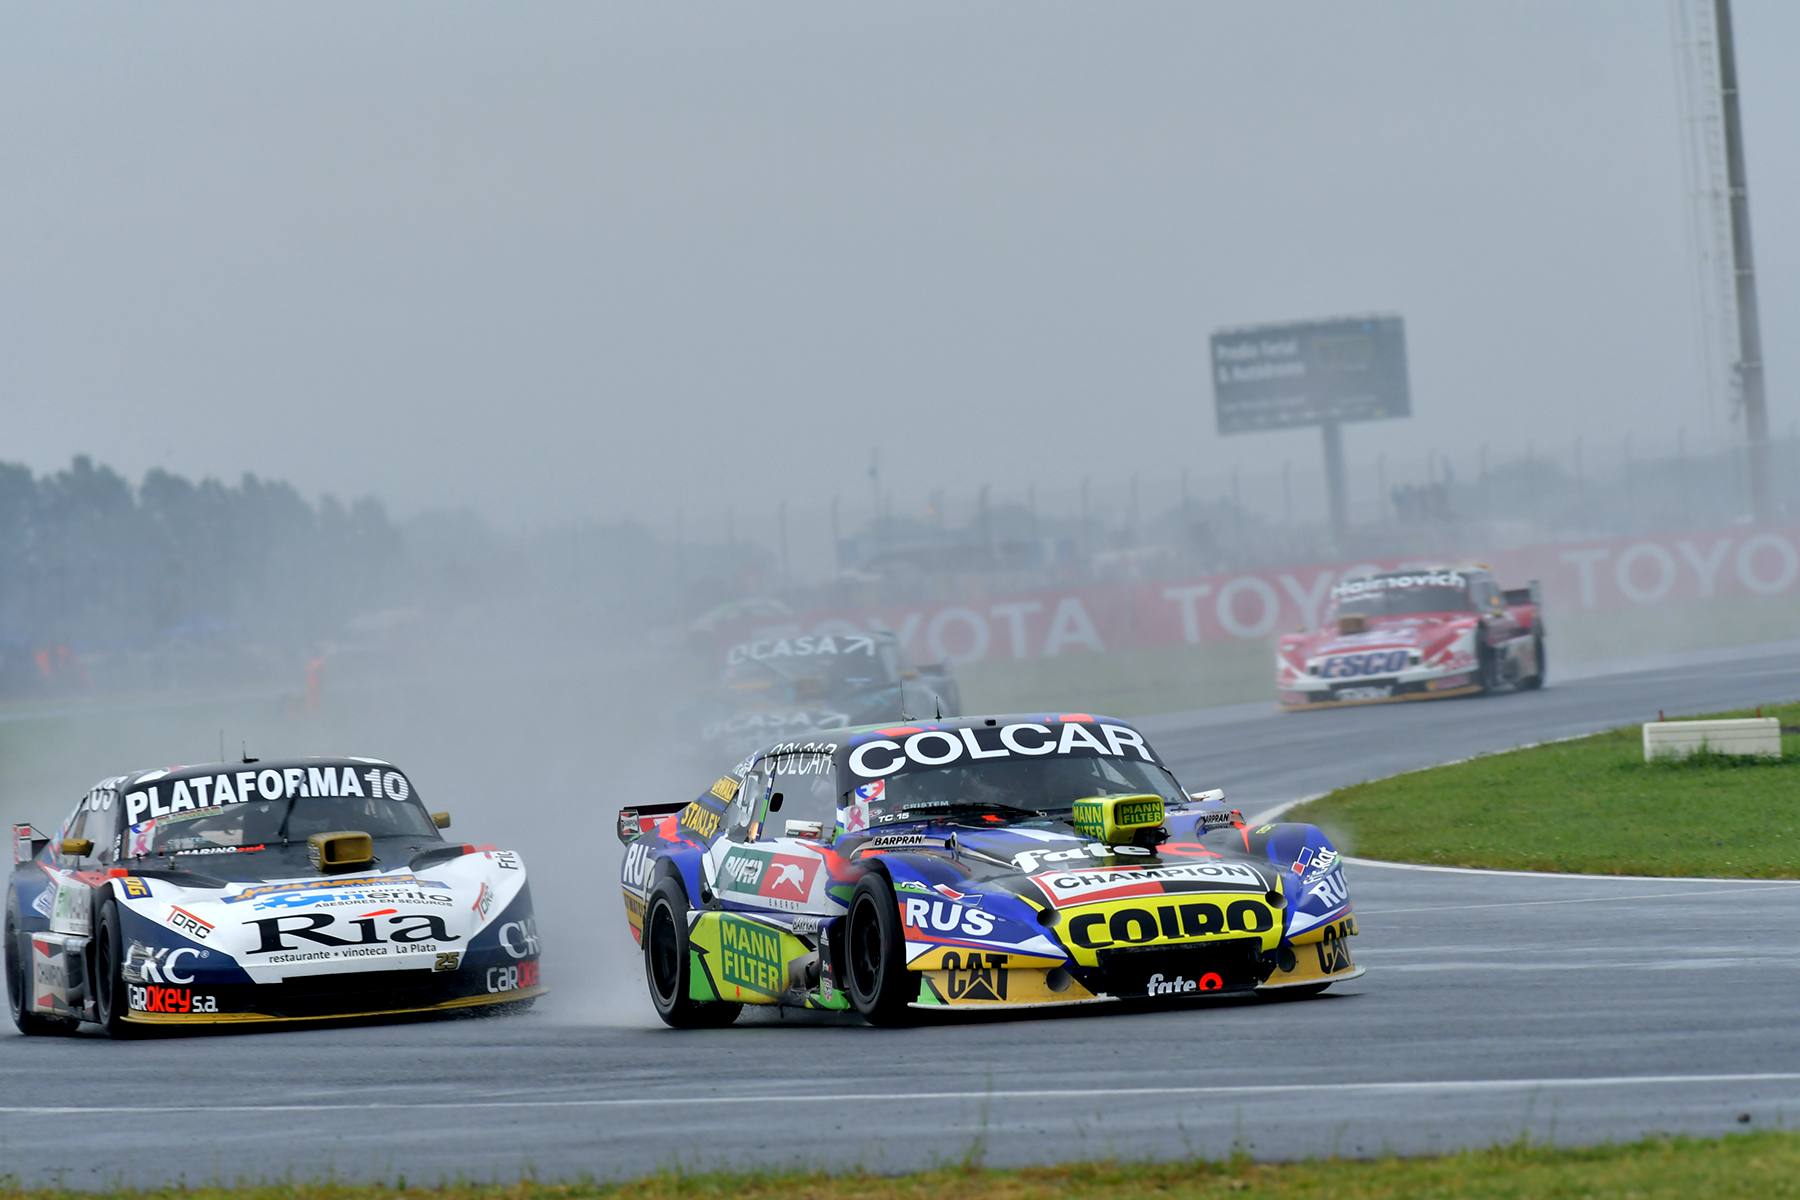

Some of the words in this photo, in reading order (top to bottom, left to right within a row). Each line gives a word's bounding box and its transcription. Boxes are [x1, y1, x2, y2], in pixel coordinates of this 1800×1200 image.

[1559, 534, 1799, 608] TOYO
[1162, 563, 1385, 644] TOY
[812, 597, 1105, 665] YOTA
[764, 742, 838, 776] COLCAR
[849, 722, 1155, 778] COLCAR
[680, 801, 721, 839] STANLEY
[879, 814, 894, 823] TC
[896, 812, 910, 820] 15
[1073, 806, 1103, 823] MANN
[1123, 803, 1160, 814] MANN
[1124, 812, 1161, 824] FILTER
[1203, 813, 1230, 824] ARPRAN
[874, 836, 923, 846] BARPRAN
[1011, 842, 1152, 874] fate
[1053, 863, 1250, 889] CHAMPION
[1308, 865, 1350, 908] RU
[314, 900, 371, 908] ASESORES
[399, 899, 453, 907] SEGUROS
[906, 897, 996, 937] RUS
[167, 904, 215, 939] TORC
[498, 918, 541, 959] CK
[1068, 899, 1274, 950] COIRO
[269, 949, 331, 964] restaurante
[342, 945, 388, 959] vinoteca
[396, 945, 406, 954] La
[411, 943, 437, 953] Plata
[721, 919, 780, 964] MANN
[434, 952, 460, 971] 25
[723, 948, 781, 994] FILTER
[941, 950, 1009, 1001] CAT
[1147, 973, 1197, 997] fate
